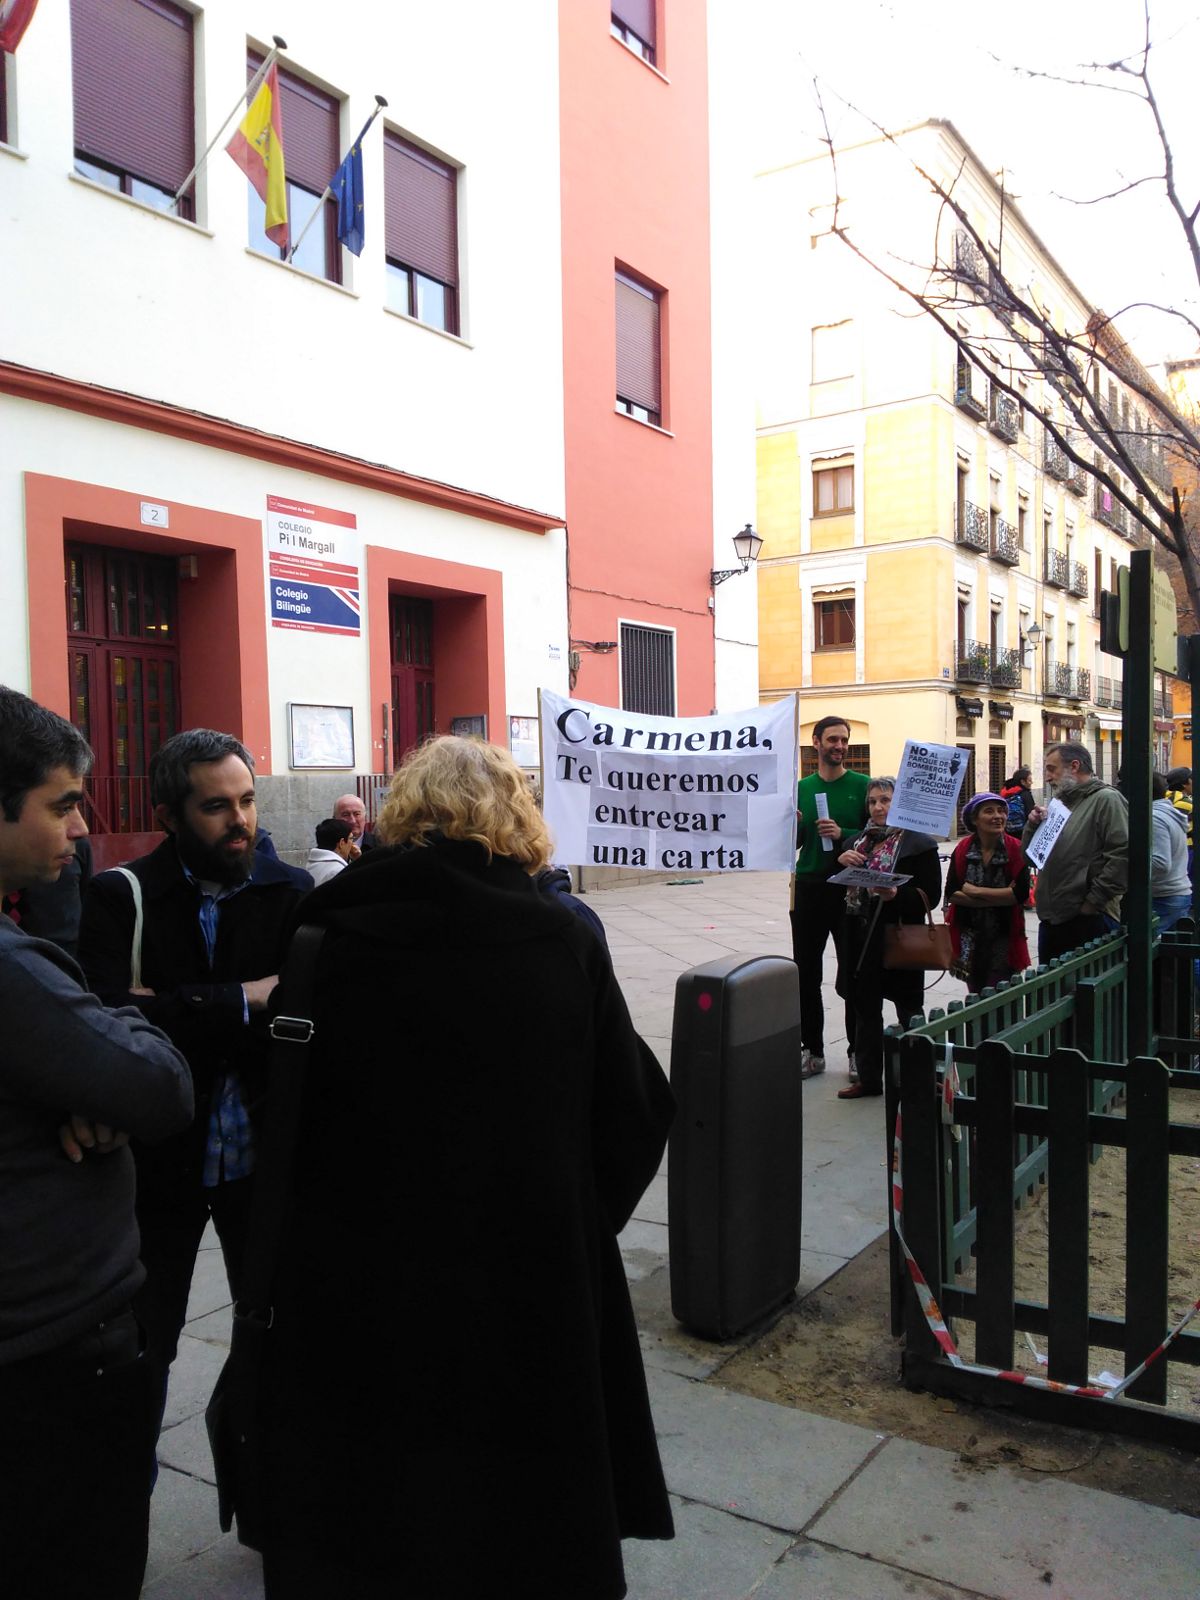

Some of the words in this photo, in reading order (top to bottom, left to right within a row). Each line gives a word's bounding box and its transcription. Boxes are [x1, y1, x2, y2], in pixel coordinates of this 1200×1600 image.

[151, 510, 158, 521] 2
[278, 521, 312, 535] COLEGIO
[280, 532, 290, 545] Pi
[299, 536, 335, 554] Margall
[275, 586, 309, 600] Colegio
[276, 600, 311, 614] Bilingüe
[556, 708, 773, 752] Carmena,
[910, 746, 928, 756] NO
[907, 761, 947, 775] BOMBEROS
[908, 754, 938, 766] PARQUE
[938, 760, 948, 768] DE
[557, 754, 593, 784] Te
[607, 769, 760, 793] queremos
[909, 776, 956, 791] DOTACIONES
[919, 786, 954, 798] SOCIALES
[595, 804, 726, 832] entregar
[592, 844, 646, 867] una
[661, 844, 745, 869] carta
